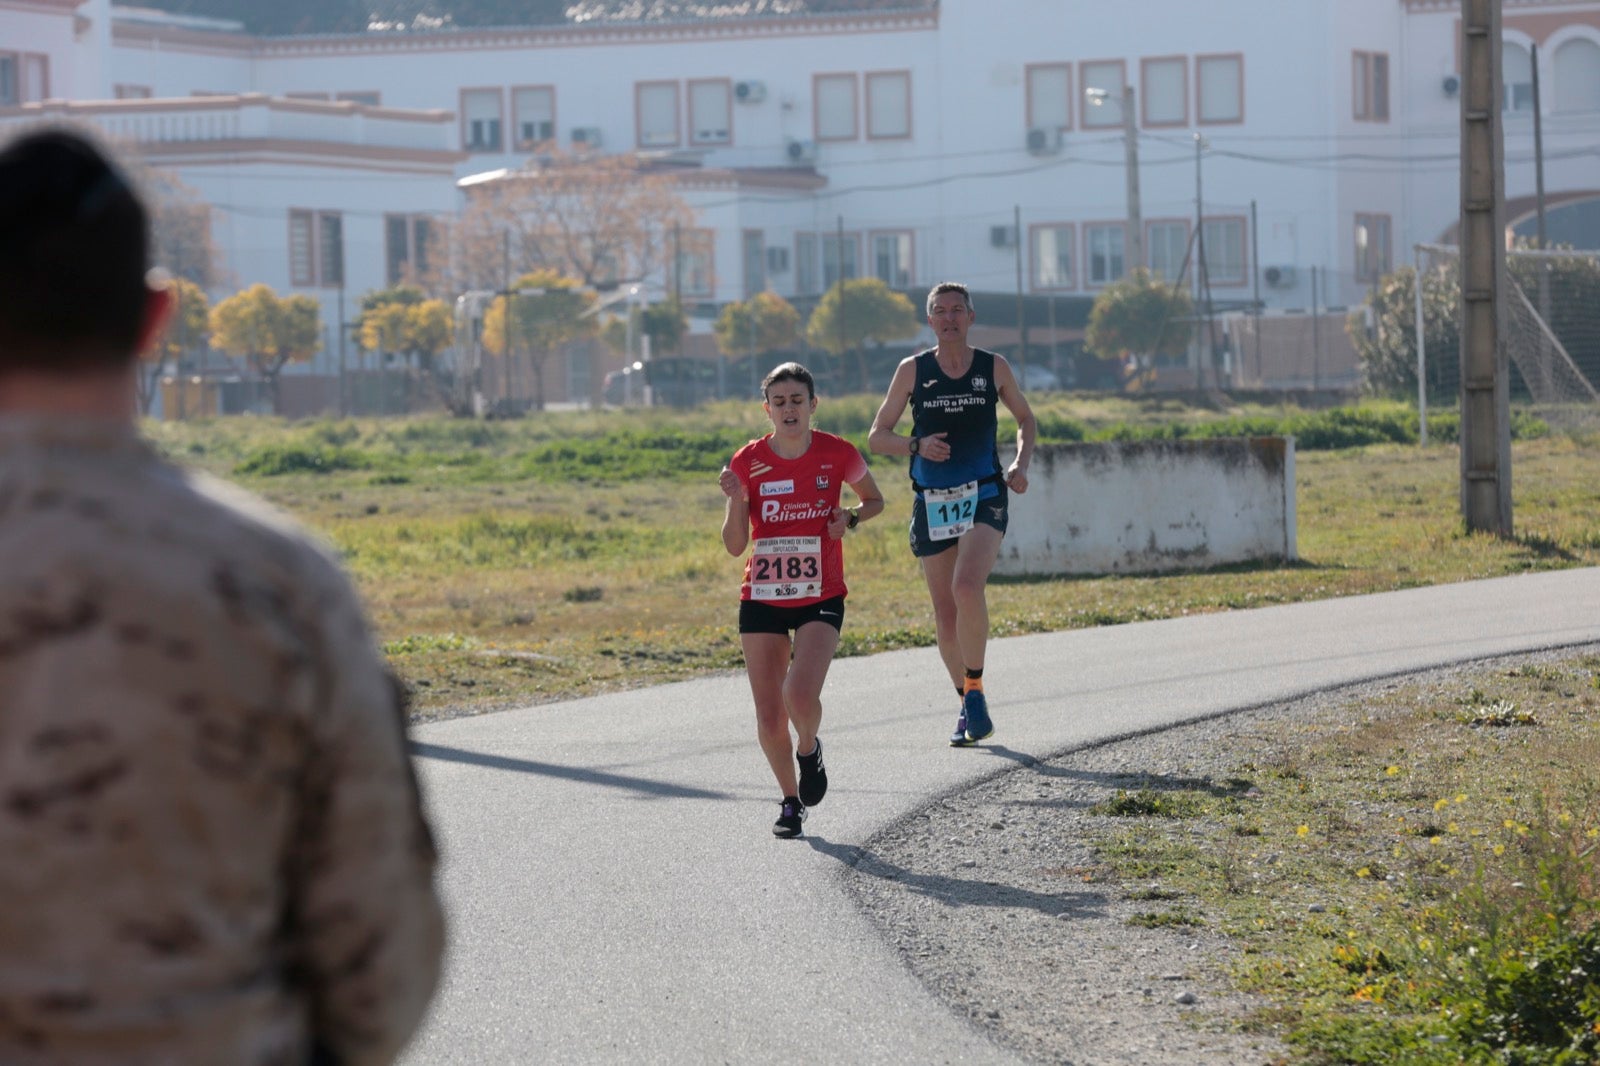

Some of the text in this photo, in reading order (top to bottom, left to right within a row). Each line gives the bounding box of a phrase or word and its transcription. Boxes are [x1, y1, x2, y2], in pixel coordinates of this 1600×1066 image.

[923, 399, 950, 408] PAZITO
[958, 397, 986, 405] PAZITO
[761, 500, 832, 523] Polisalud
[783, 502, 810, 511] Clínicas
[938, 499, 972, 523] 112
[755, 556, 818, 581] 2183
